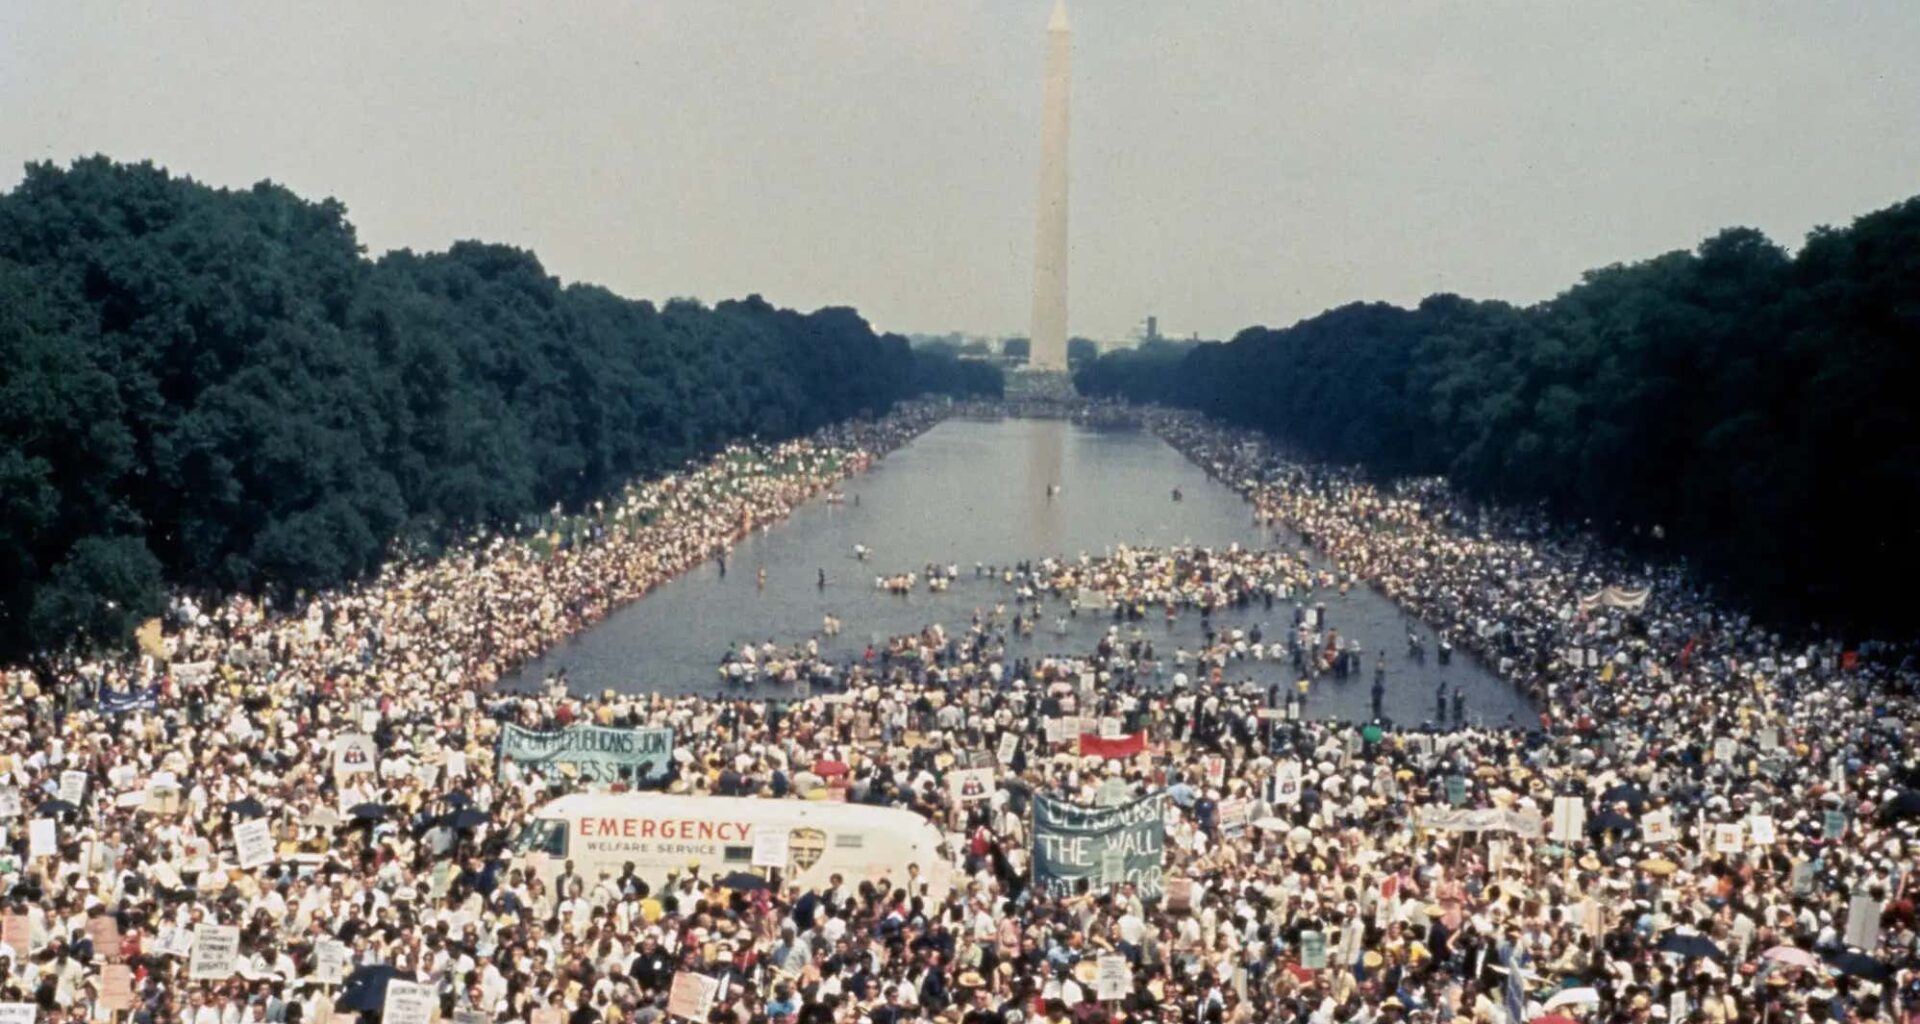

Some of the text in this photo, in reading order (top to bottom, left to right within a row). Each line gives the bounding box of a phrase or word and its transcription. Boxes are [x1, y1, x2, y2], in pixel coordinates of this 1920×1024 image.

[638, 731, 666, 754] JOIN
[580, 817, 752, 841] EMERGENCY
[587, 841, 717, 855] WELFARE SERVICE
[1037, 833, 1095, 866] THE
[1104, 829, 1159, 858] WALL
